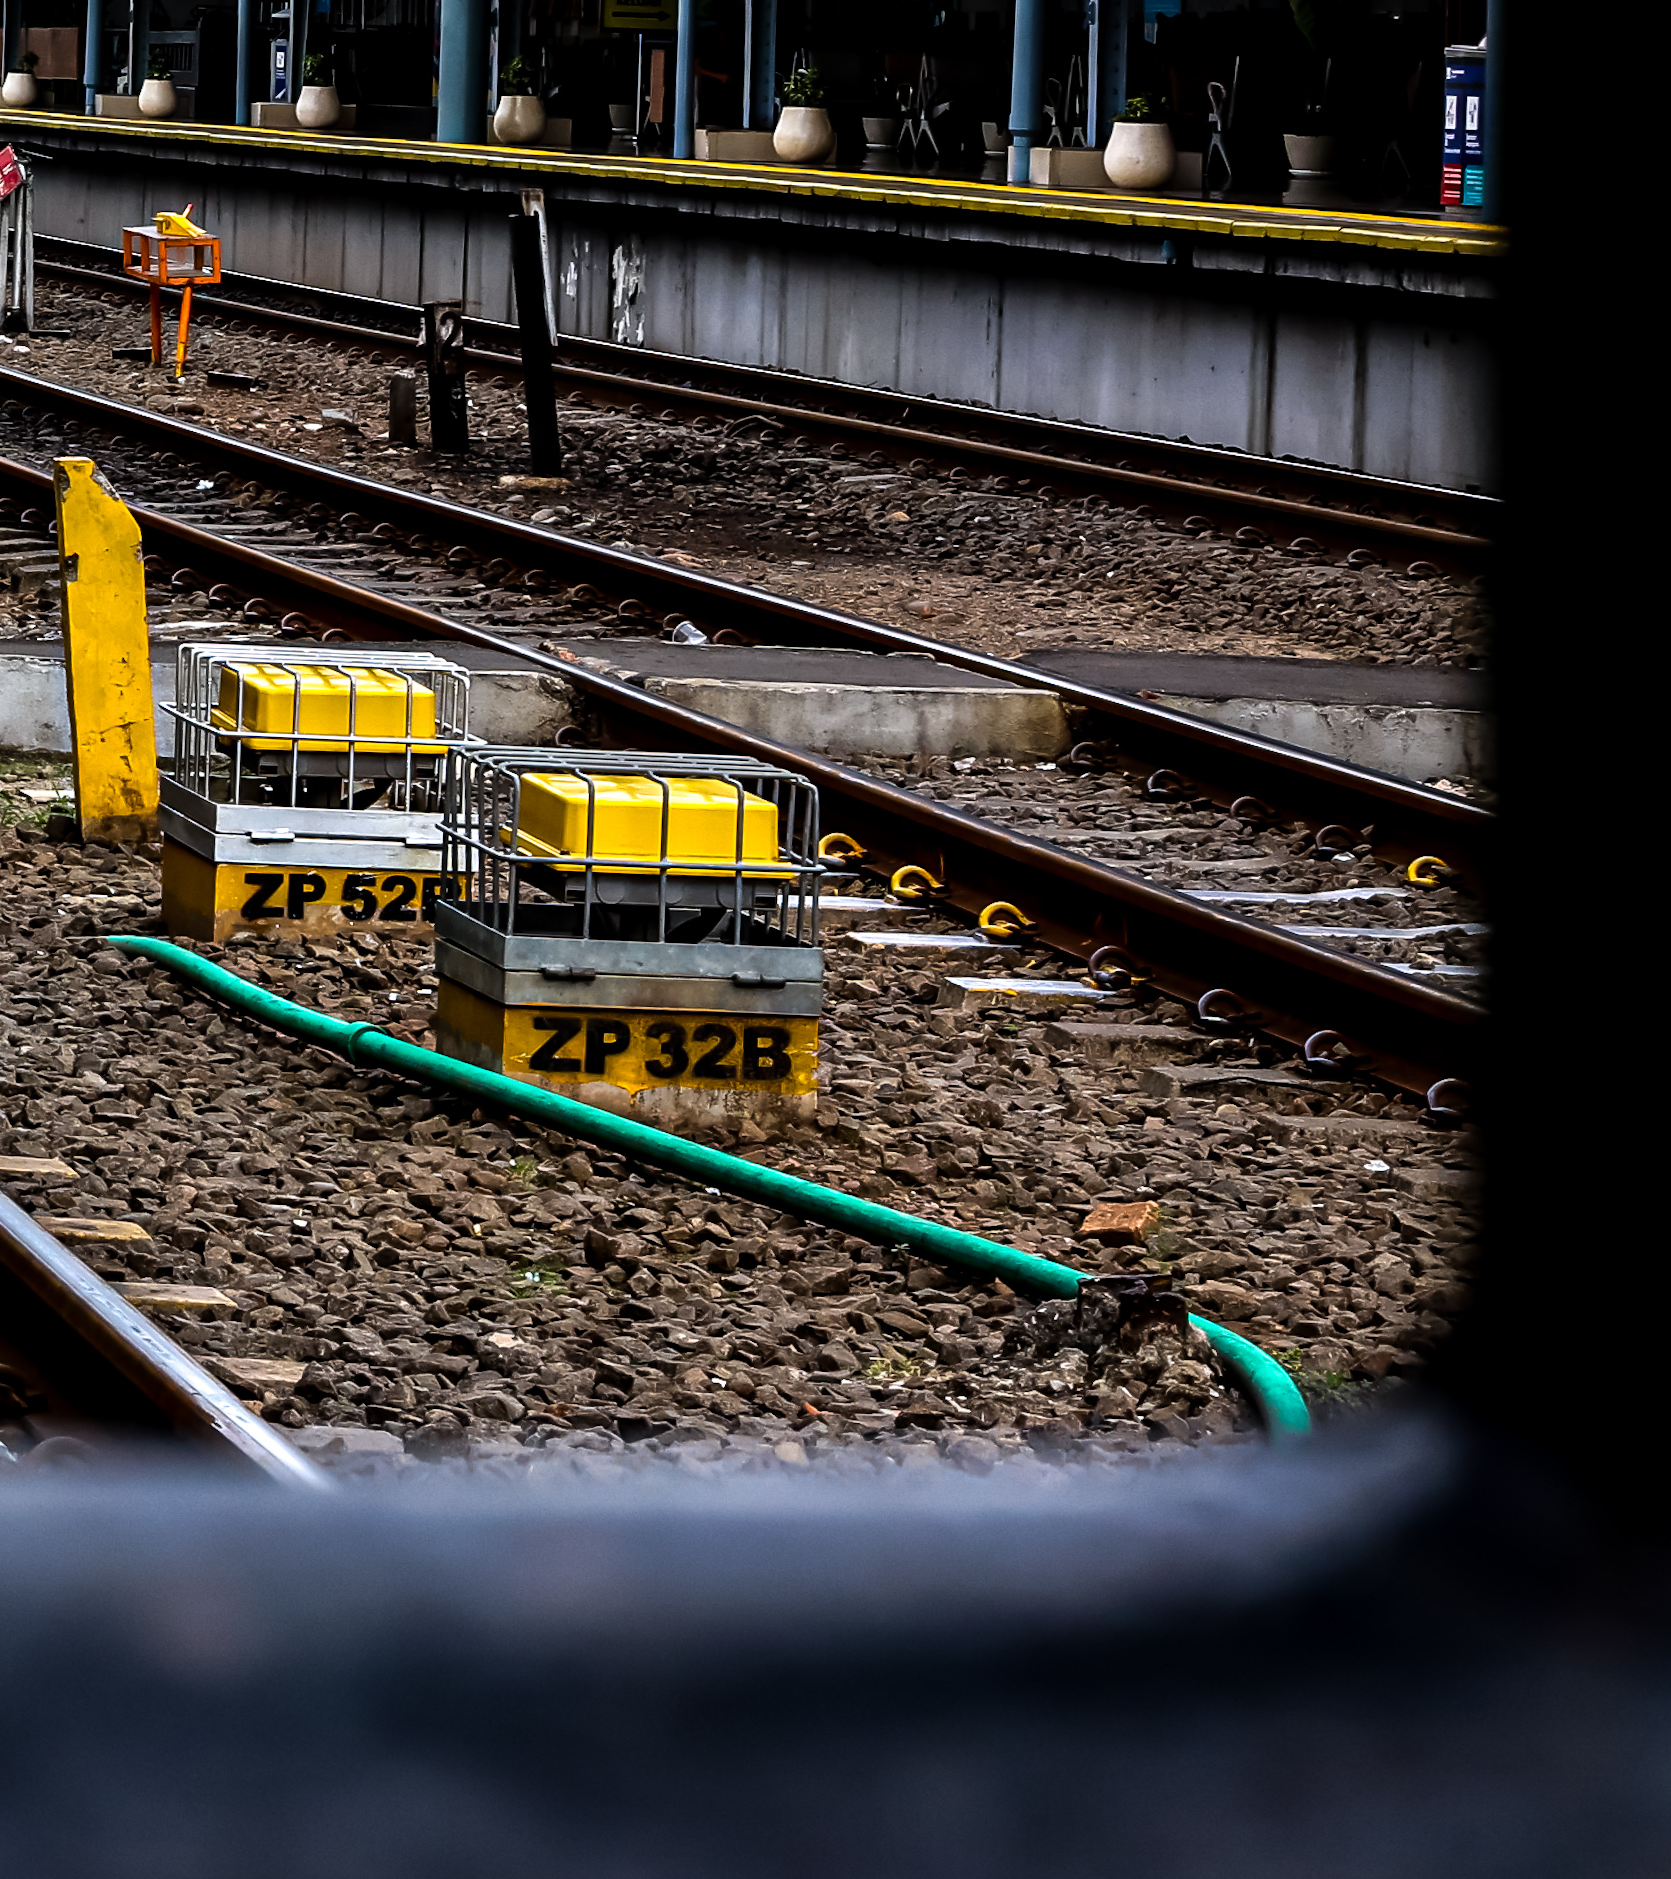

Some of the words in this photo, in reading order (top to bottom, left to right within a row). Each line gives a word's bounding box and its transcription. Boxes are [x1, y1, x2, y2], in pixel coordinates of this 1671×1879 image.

[240, 872, 327, 921] ZP
[529, 1016, 631, 1075] ZP
[643, 1021, 794, 1081] 32B
